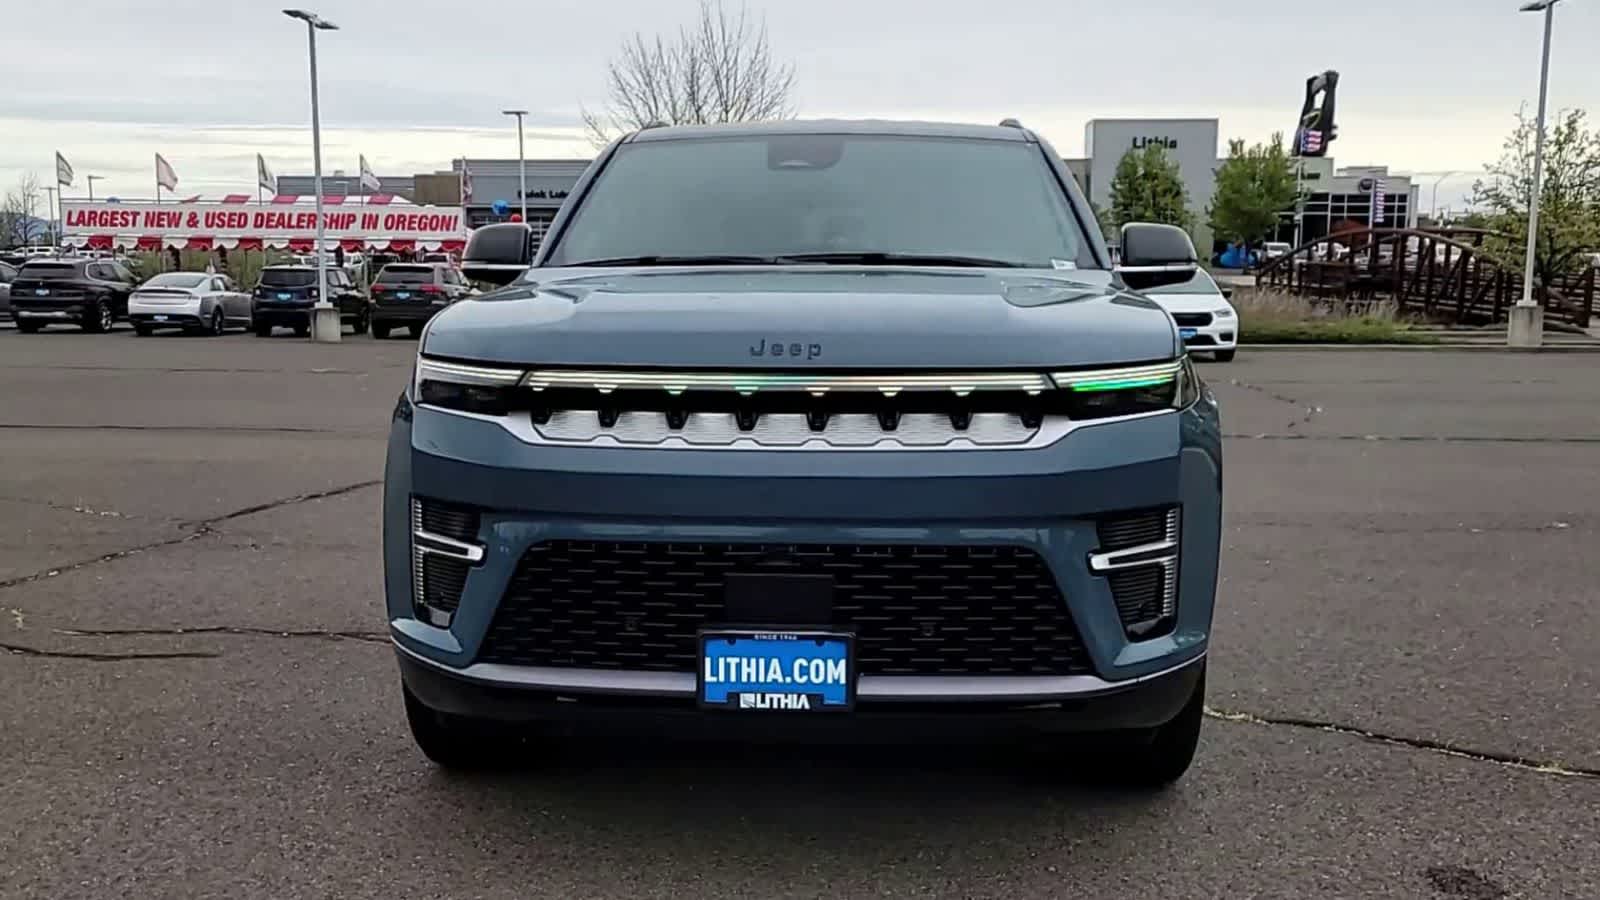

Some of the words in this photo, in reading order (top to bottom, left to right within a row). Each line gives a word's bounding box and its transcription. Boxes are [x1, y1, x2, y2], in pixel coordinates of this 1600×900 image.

[549, 189, 570, 199] Lub
[66, 210, 140, 228] LARGEST
[144, 211, 183, 228] NEW
[186, 212, 200, 228] &
[204, 212, 248, 229] USED
[253, 212, 357, 230] DEALERSHIP
[361, 213, 379, 230] IN
[383, 213, 458, 231] OREGON!
[750, 338, 822, 360] Jeep
[704, 656, 847, 684] LITHIA.COM
[756, 693, 811, 710] LITHIA
